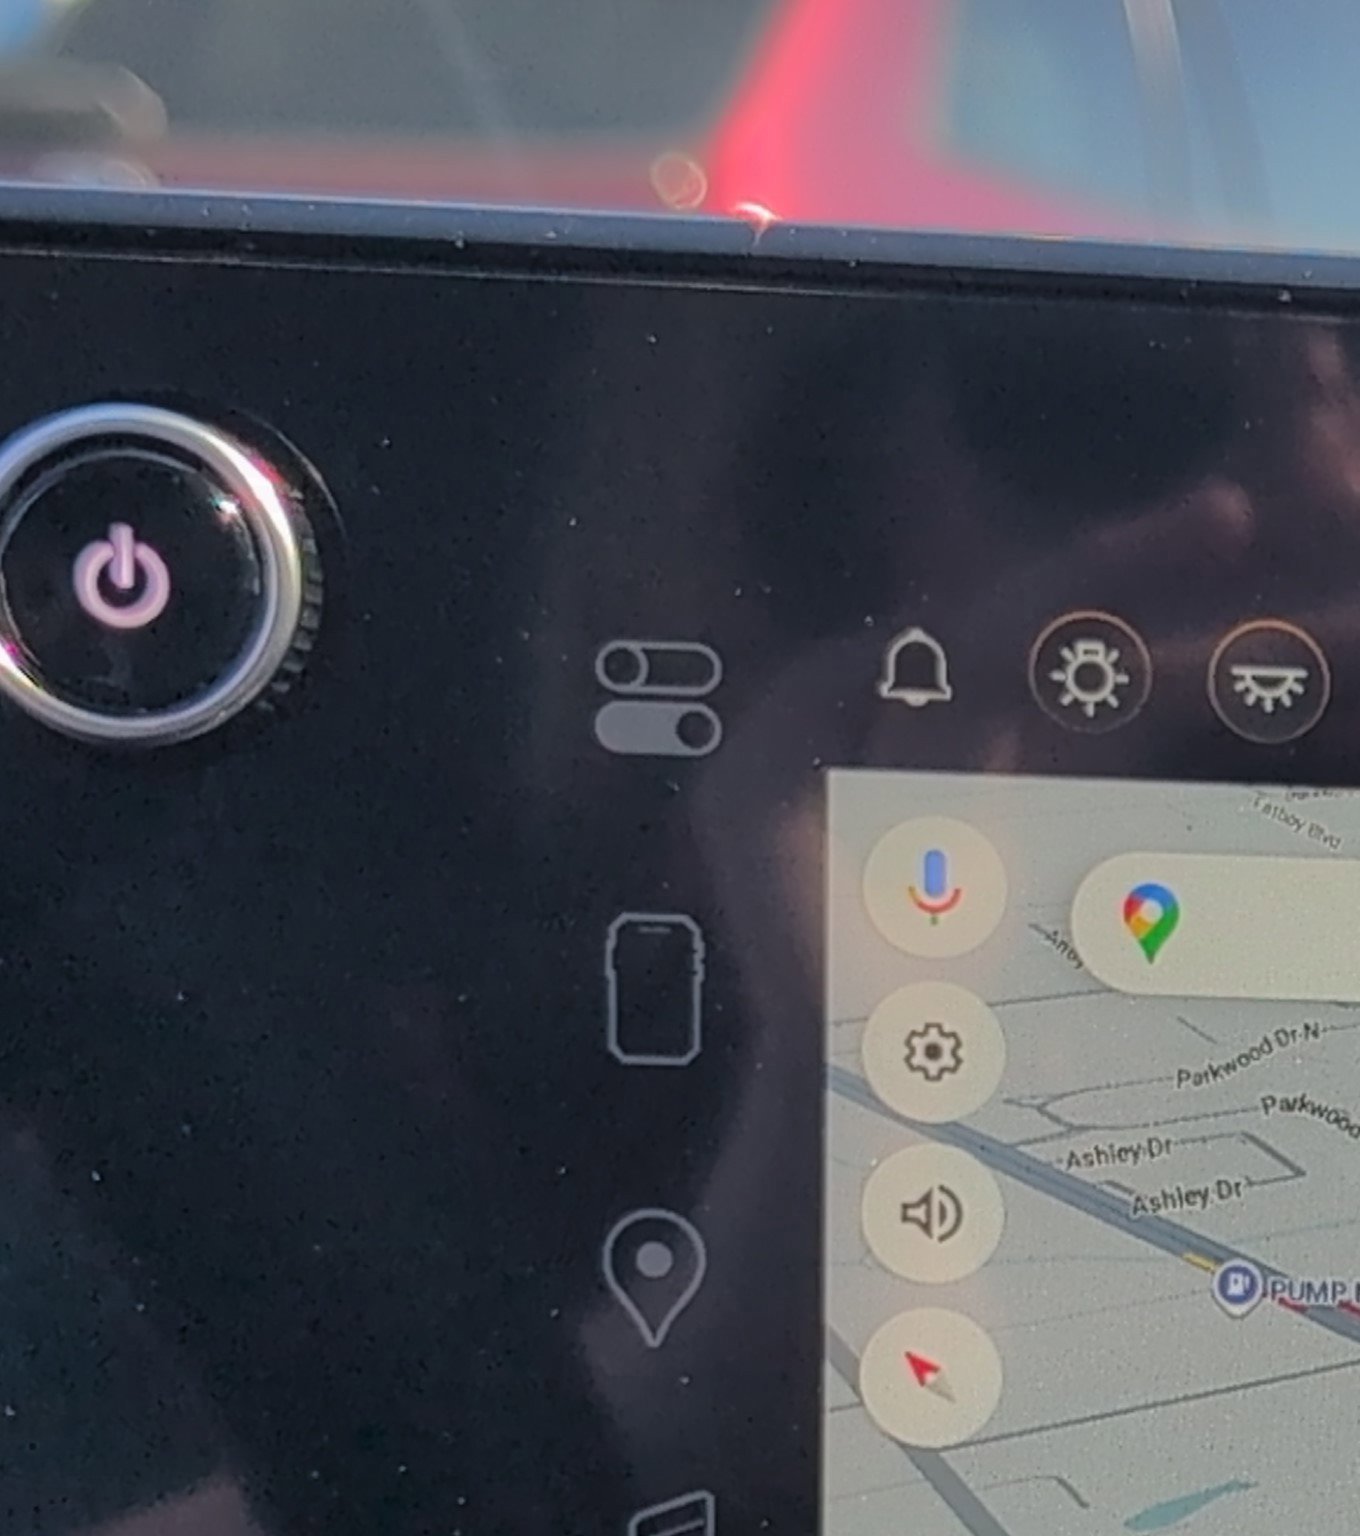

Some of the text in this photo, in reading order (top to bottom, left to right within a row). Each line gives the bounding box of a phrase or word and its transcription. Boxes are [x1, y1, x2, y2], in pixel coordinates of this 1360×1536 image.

[1176, 1022, 1322, 1089] Parkwood Dr N
[1066, 1136, 1175, 1172] Ashley Dr
[1131, 1177, 1244, 1217] Ashley Dr
[1270, 1280, 1347, 1302] PUMP
